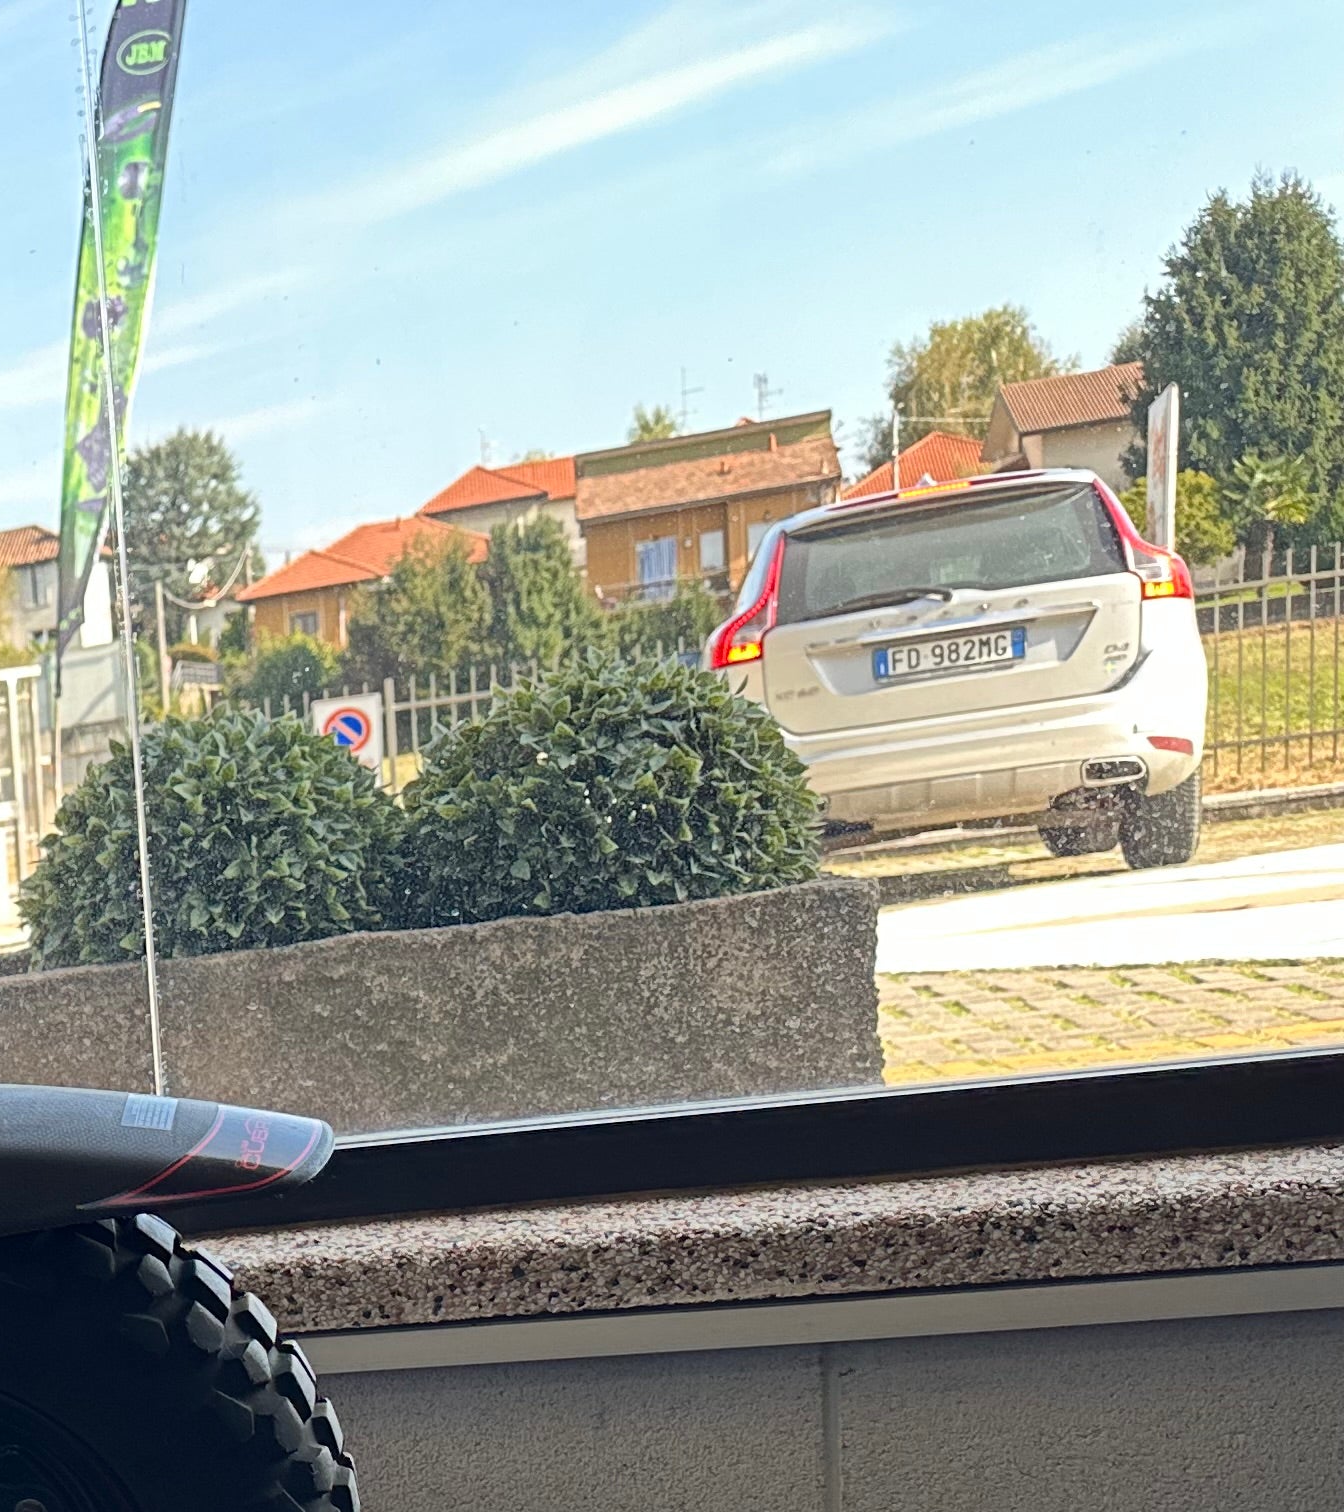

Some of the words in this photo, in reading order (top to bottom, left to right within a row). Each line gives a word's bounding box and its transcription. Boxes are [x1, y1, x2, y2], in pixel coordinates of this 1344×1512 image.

[125, 40, 167, 66] JBM
[891, 647, 921, 673] FD
[933, 636, 1009, 667] 982MG
